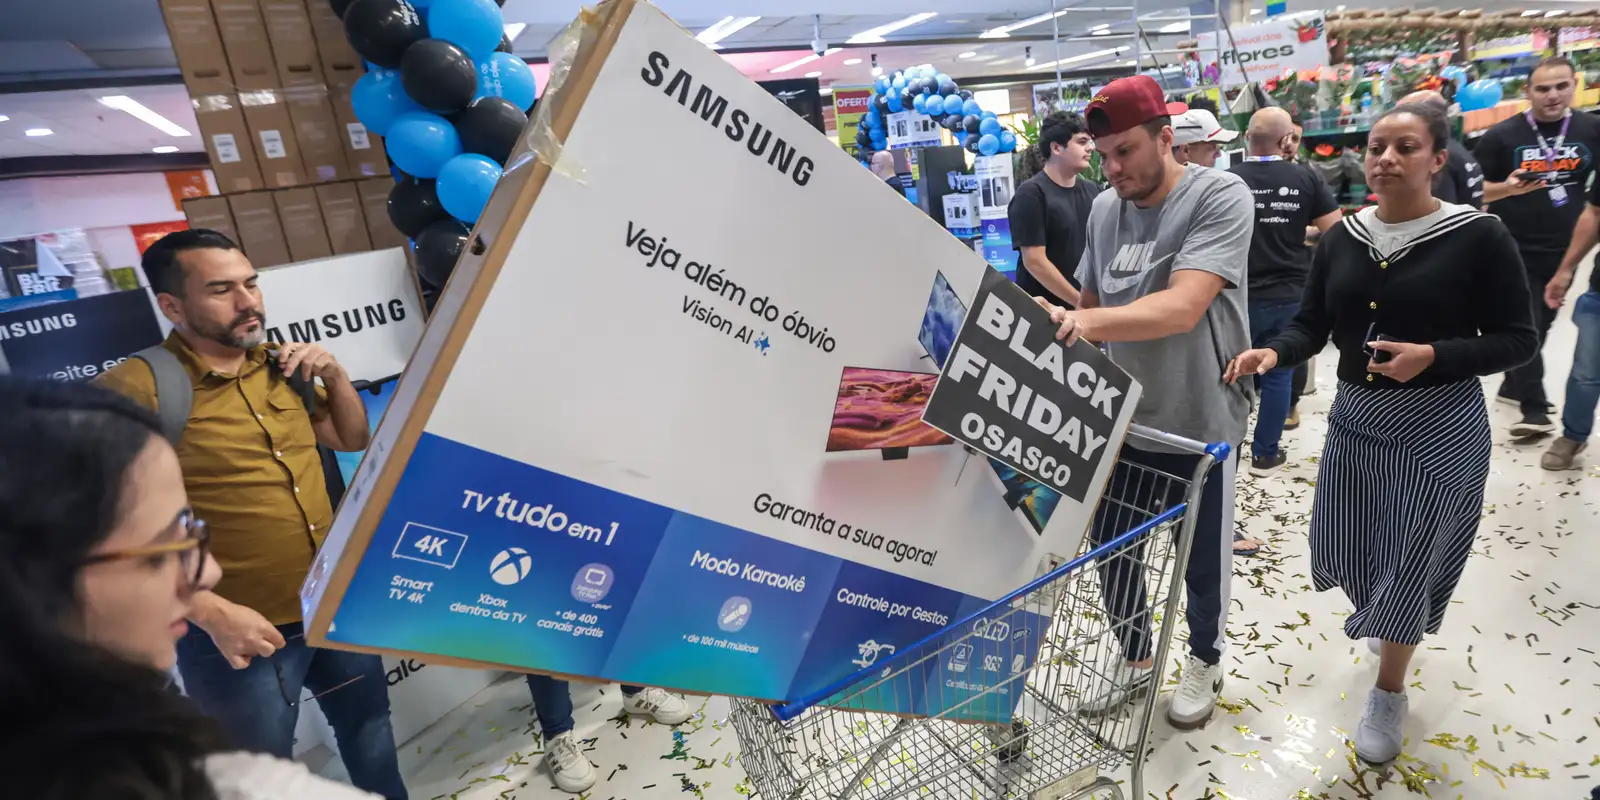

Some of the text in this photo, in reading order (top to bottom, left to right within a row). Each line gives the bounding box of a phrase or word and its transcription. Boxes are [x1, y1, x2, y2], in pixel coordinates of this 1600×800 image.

[1221, 44, 1294, 64] flores
[640, 51, 814, 186] SAMSUNG
[1522, 146, 1579, 160] BLCK
[624, 220, 836, 353] Veja além do óbvio
[682, 295, 754, 345] Vision AI
[976, 291, 1122, 420] BLACK
[947, 342, 1108, 461] FRIDAY
[960, 412, 1072, 488] OSASCO
[462, 490, 620, 546] TV tudo em 1
[754, 493, 938, 566] Garanta a sua agora!
[414, 535, 448, 556] 4K
[390, 575, 434, 592] Smart
[690, 550, 806, 592] Modo Karaokê
[389, 588, 426, 604] TV 4K
[477, 593, 508, 608] Xbox
[837, 588, 948, 626] Controle por Gestos
[450, 602, 527, 624] dentro da TV
[536, 618, 604, 638] canais grátis
[562, 610, 578, 620] de
[578, 613, 598, 624] 400
[687, 634, 700, 643] de
[700, 636, 715, 646] 100
[714, 638, 728, 648] mil
[727, 640, 760, 654] músicas
